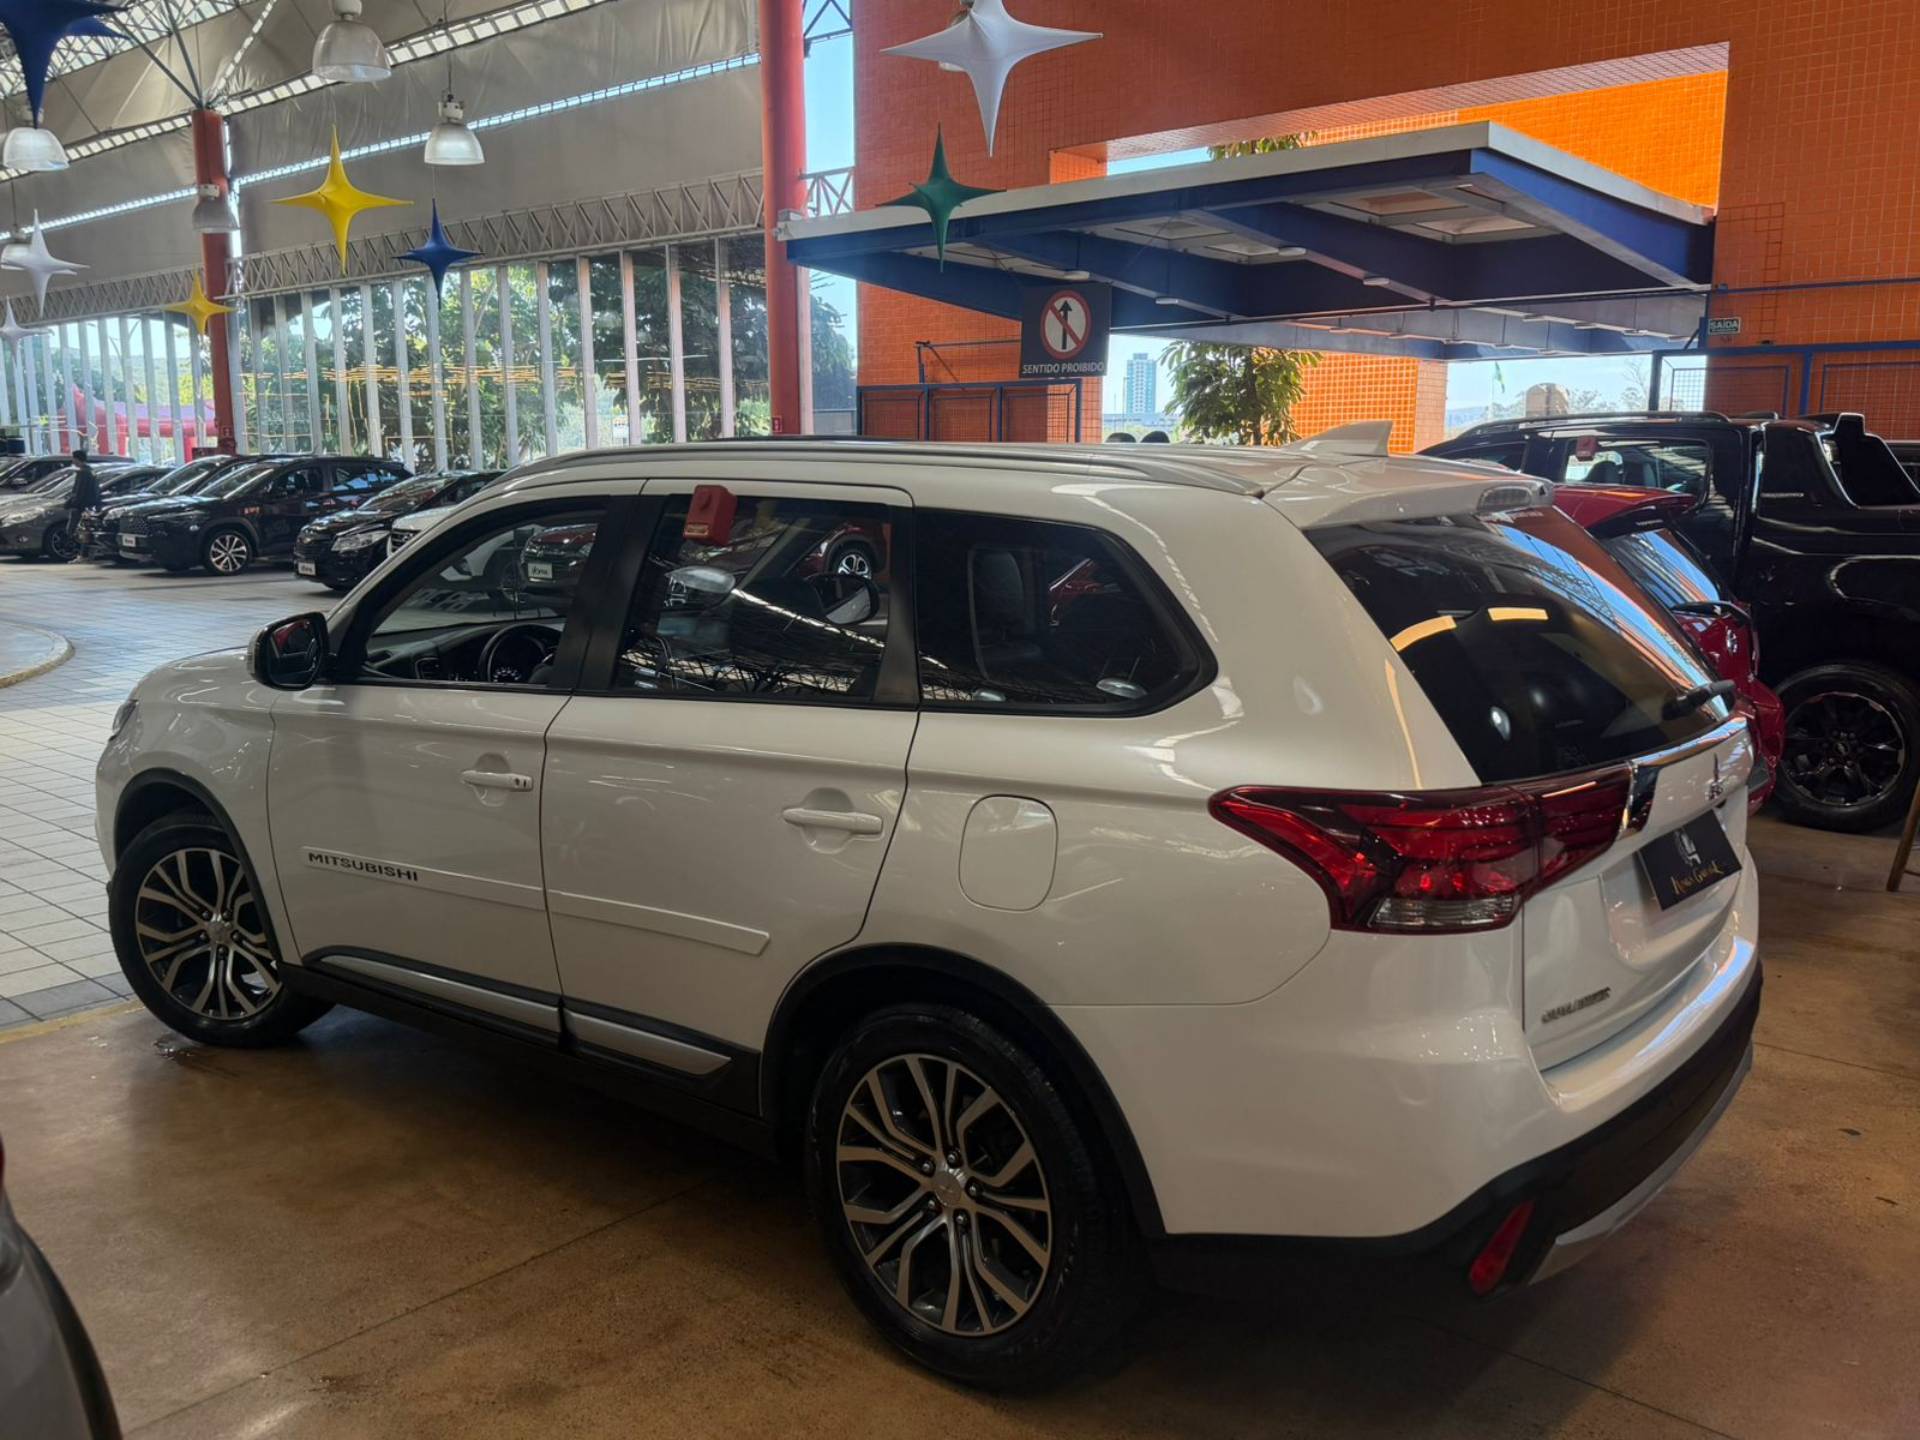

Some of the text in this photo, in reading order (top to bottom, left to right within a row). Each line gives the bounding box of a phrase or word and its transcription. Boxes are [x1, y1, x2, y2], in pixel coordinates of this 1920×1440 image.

[1022, 362, 1105, 374] SENTIDO PROIBIDO
[308, 852, 418, 881] MITSUBISHI
